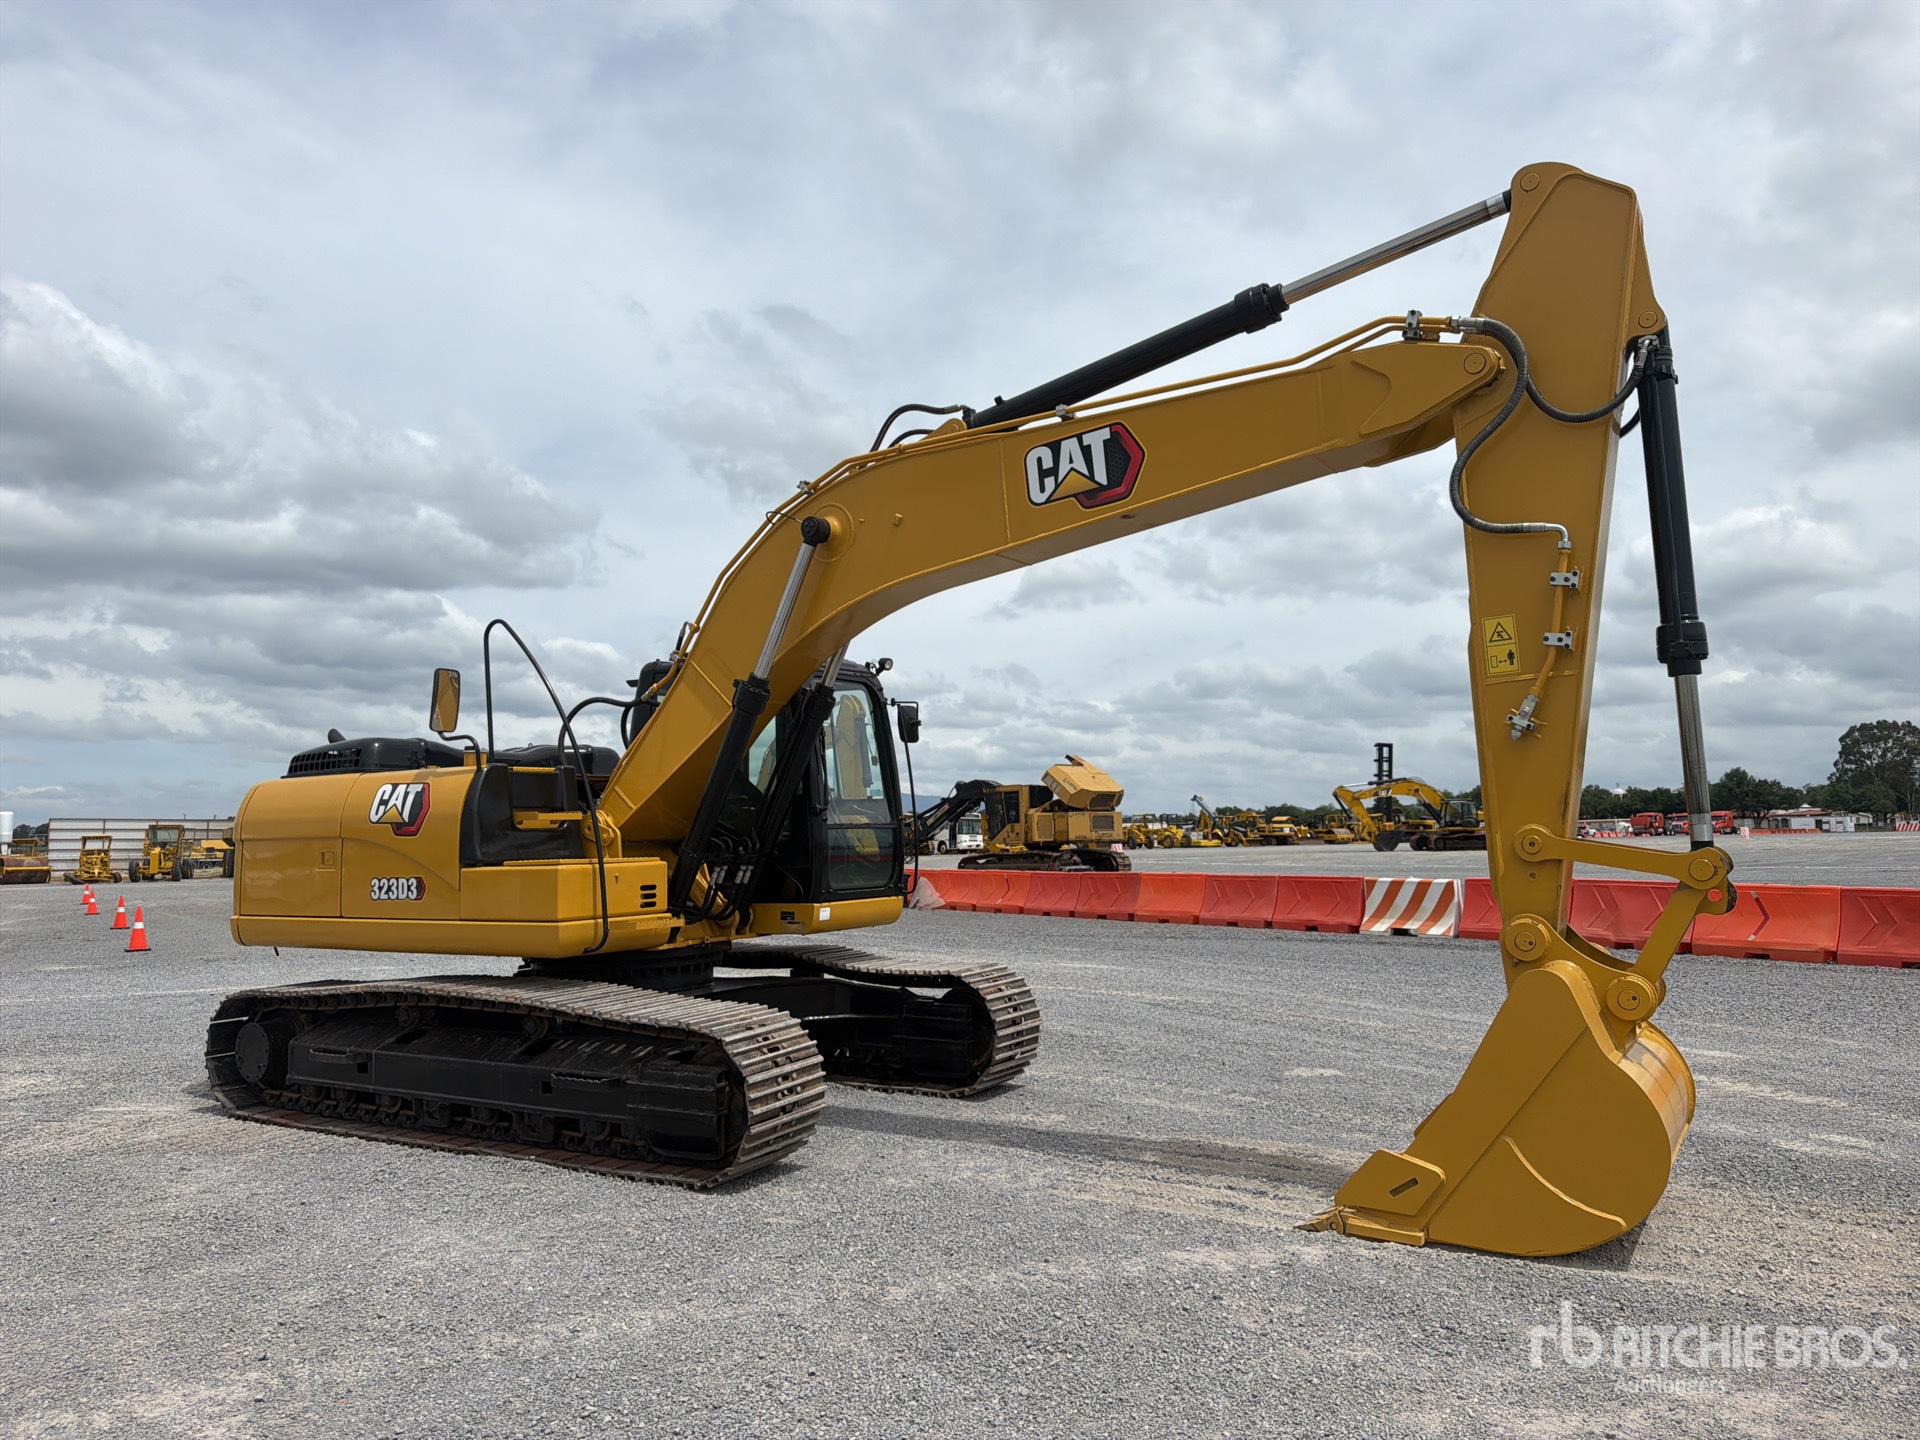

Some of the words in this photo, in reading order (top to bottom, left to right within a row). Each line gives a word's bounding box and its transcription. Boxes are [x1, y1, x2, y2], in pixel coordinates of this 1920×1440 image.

[1026, 427, 1112, 504] CAT
[370, 783, 424, 823] CAT
[371, 878, 417, 900] 323D3
